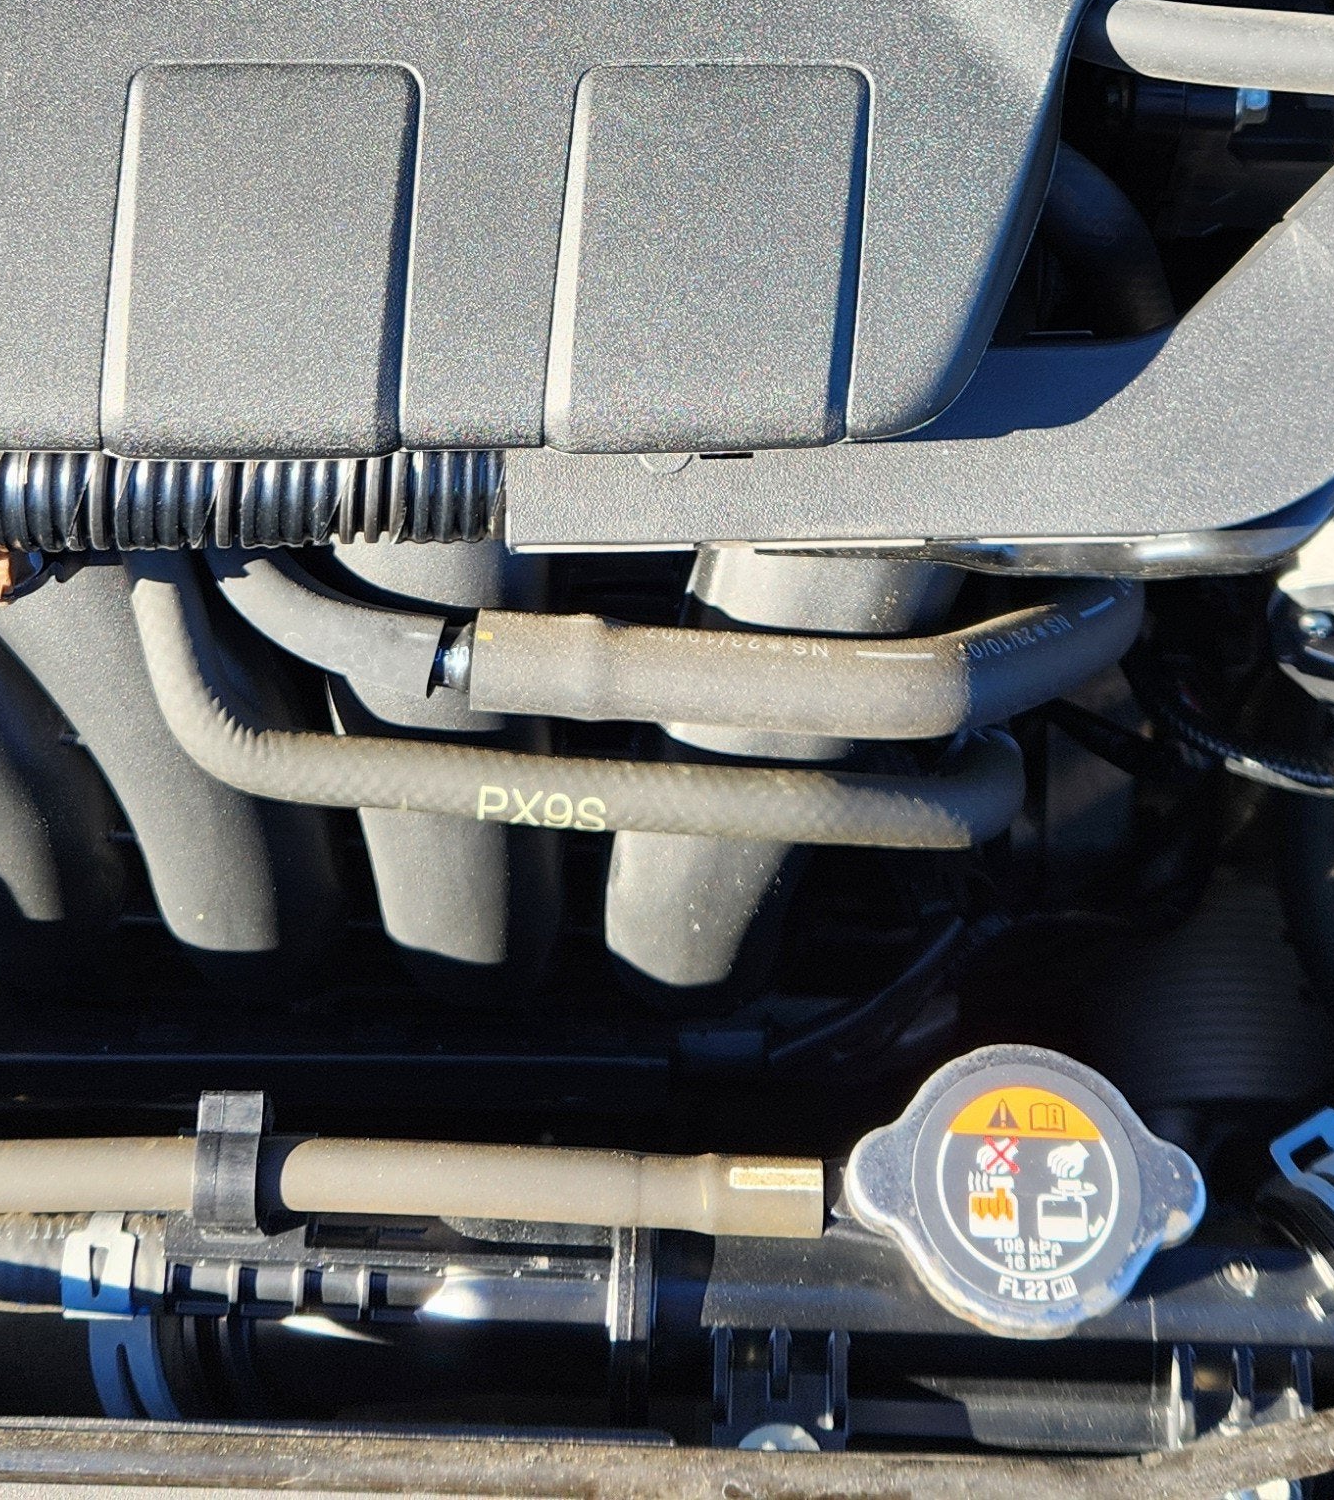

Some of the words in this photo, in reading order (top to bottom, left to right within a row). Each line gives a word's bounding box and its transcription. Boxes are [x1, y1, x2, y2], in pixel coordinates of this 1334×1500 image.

[476, 785, 607, 832] PX9S
[994, 1237, 1026, 1253] 108
[1028, 1236, 1063, 1256] kPa
[1005, 1253, 1026, 1271] 16
[1029, 1253, 1056, 1271] psi
[998, 1274, 1050, 1301] FL22
